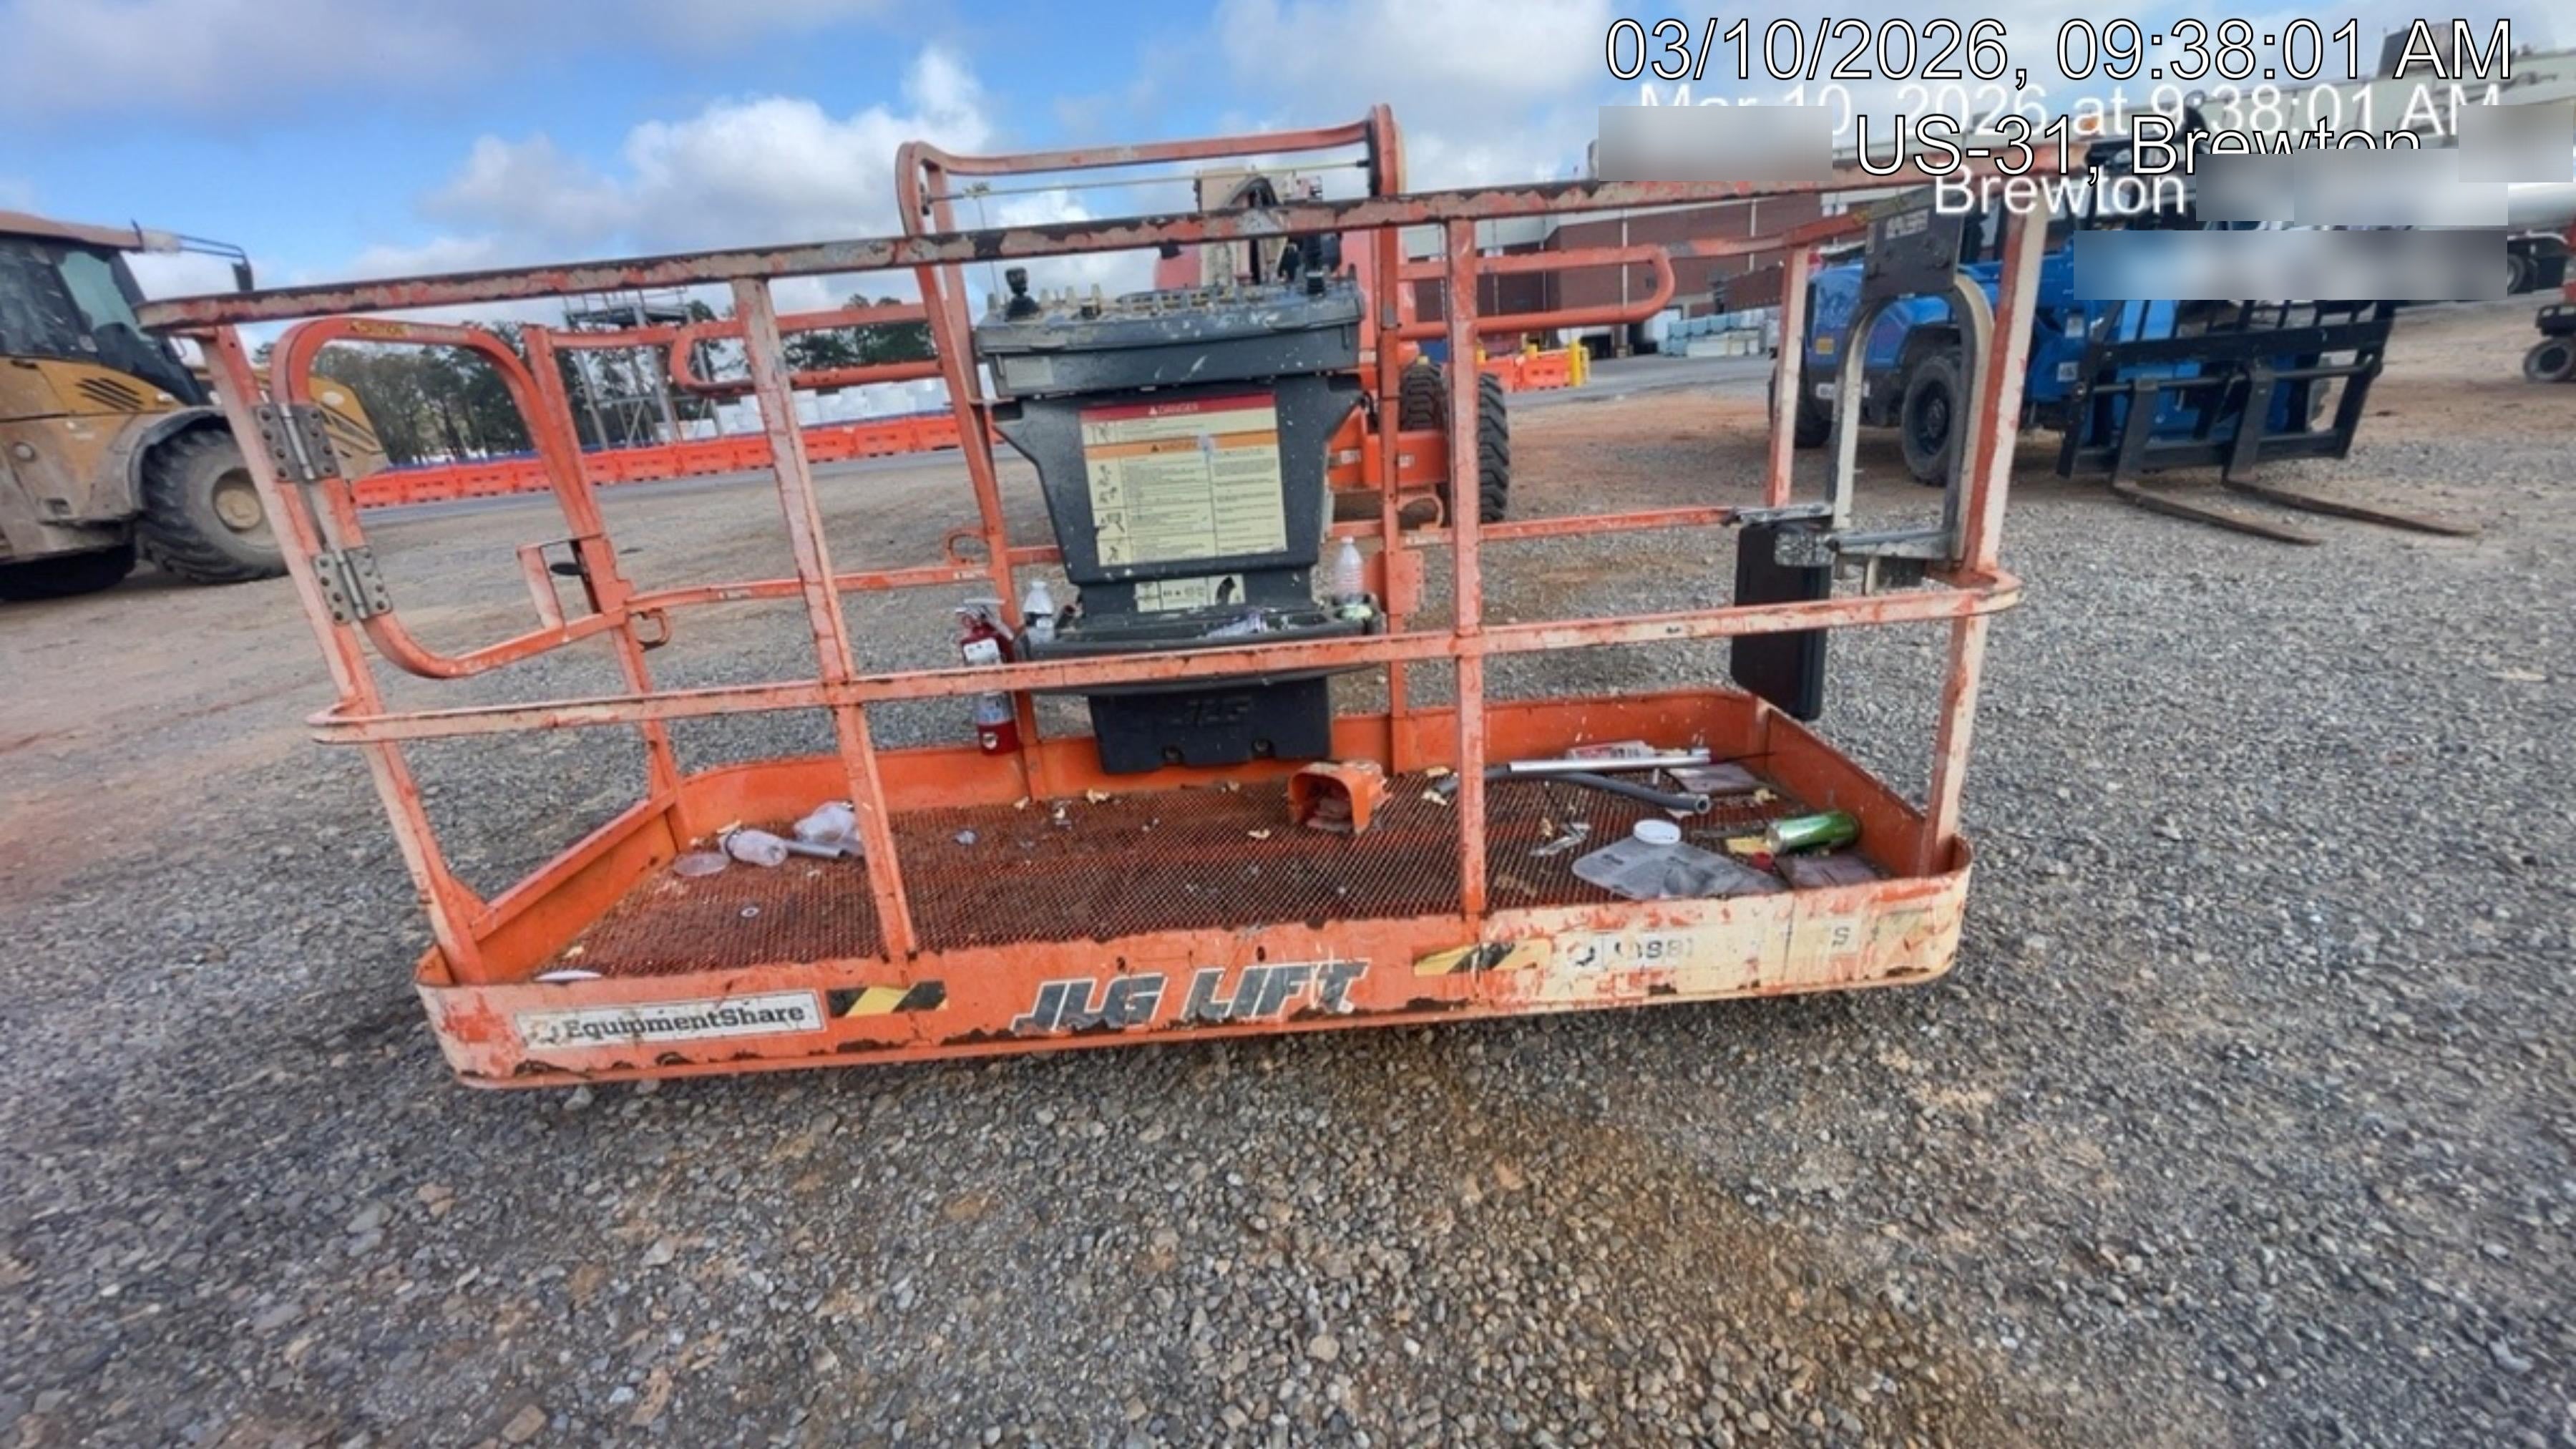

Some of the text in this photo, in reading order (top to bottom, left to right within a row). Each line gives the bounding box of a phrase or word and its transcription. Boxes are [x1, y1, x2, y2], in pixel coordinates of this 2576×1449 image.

[564, 1005, 804, 1040] EquipmentShare
[1010, 959, 1370, 1033] JLG LIFT
